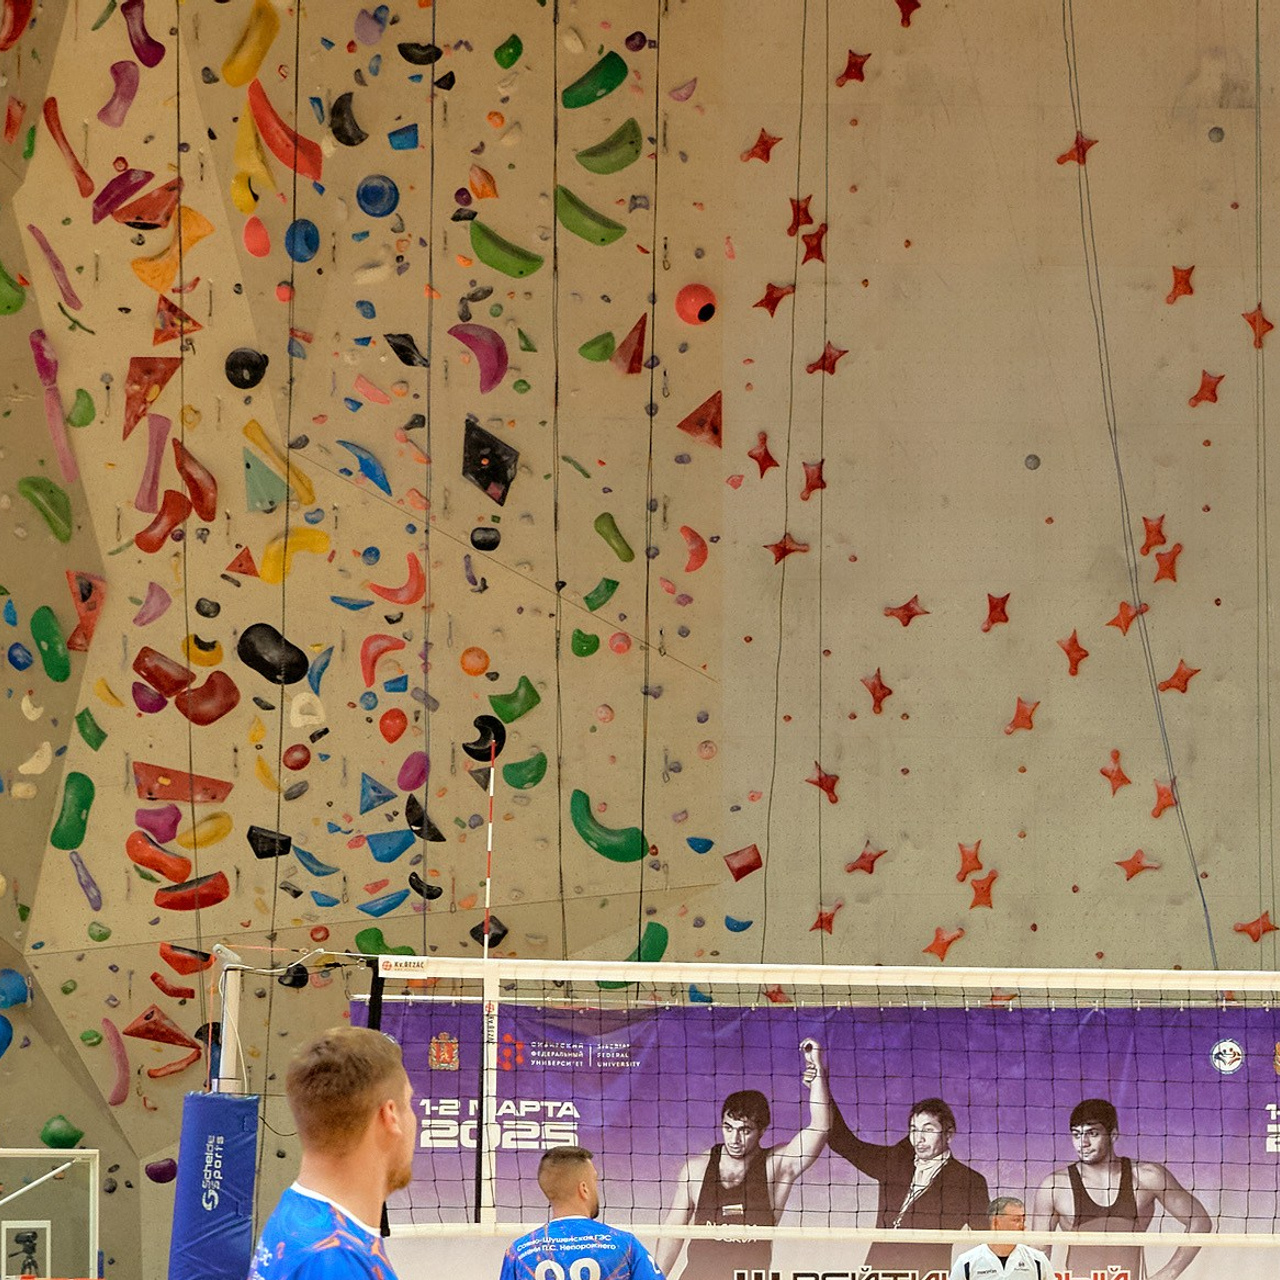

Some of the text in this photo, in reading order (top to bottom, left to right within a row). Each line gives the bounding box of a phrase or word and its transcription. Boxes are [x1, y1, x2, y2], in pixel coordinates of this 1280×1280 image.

[419, 1098, 460, 1116] 1-2
[420, 1120, 579, 1149] 2025
[202, 1135, 215, 1189] Schelde
[211, 1135, 224, 1189] Sports
